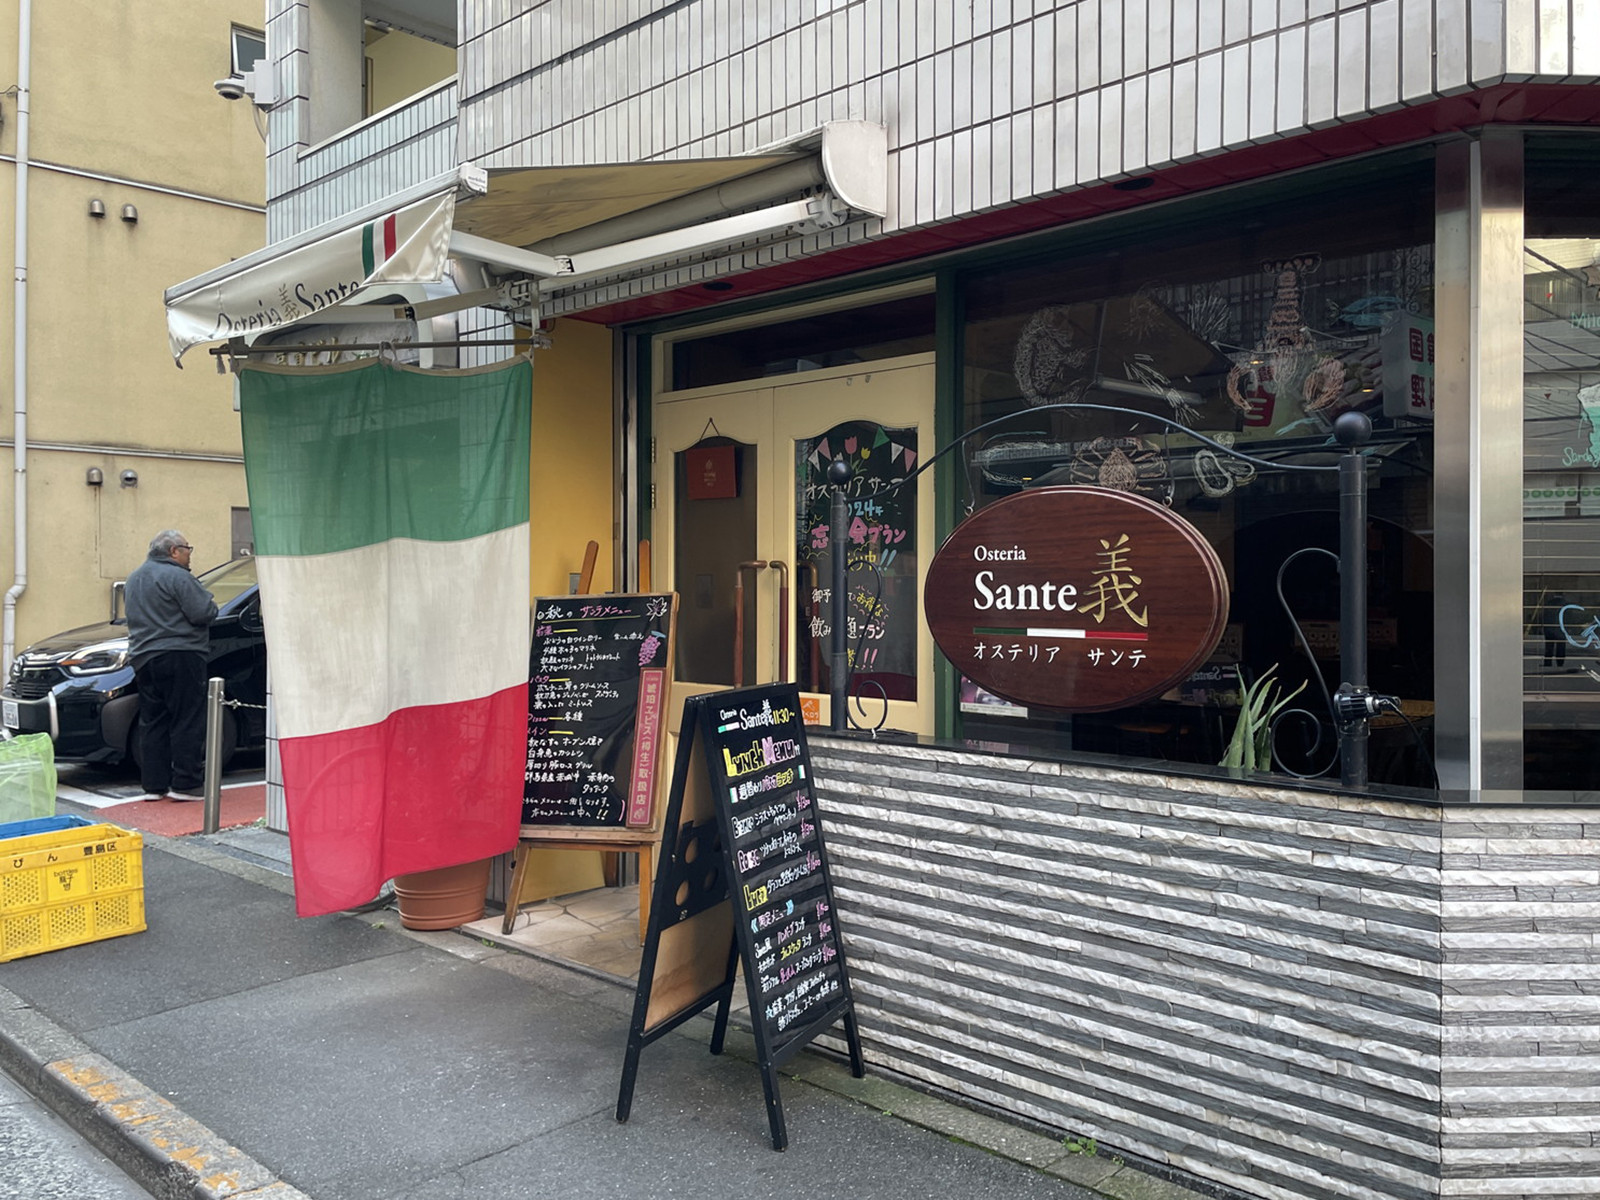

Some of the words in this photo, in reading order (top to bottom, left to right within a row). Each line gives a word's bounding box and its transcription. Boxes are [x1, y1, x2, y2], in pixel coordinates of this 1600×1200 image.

[811, 516, 907, 549] 忘会プラン
[974, 545, 1027, 562] Osteria
[973, 570, 1078, 612] Sante
[1076, 533, 1149, 627] 義
[808, 615, 885, 640] 飲み題プラン
[973, 642, 1060, 663] オステリア
[1087, 647, 1147, 668] サンテ
[83, 841, 117, 857] 豊島区
